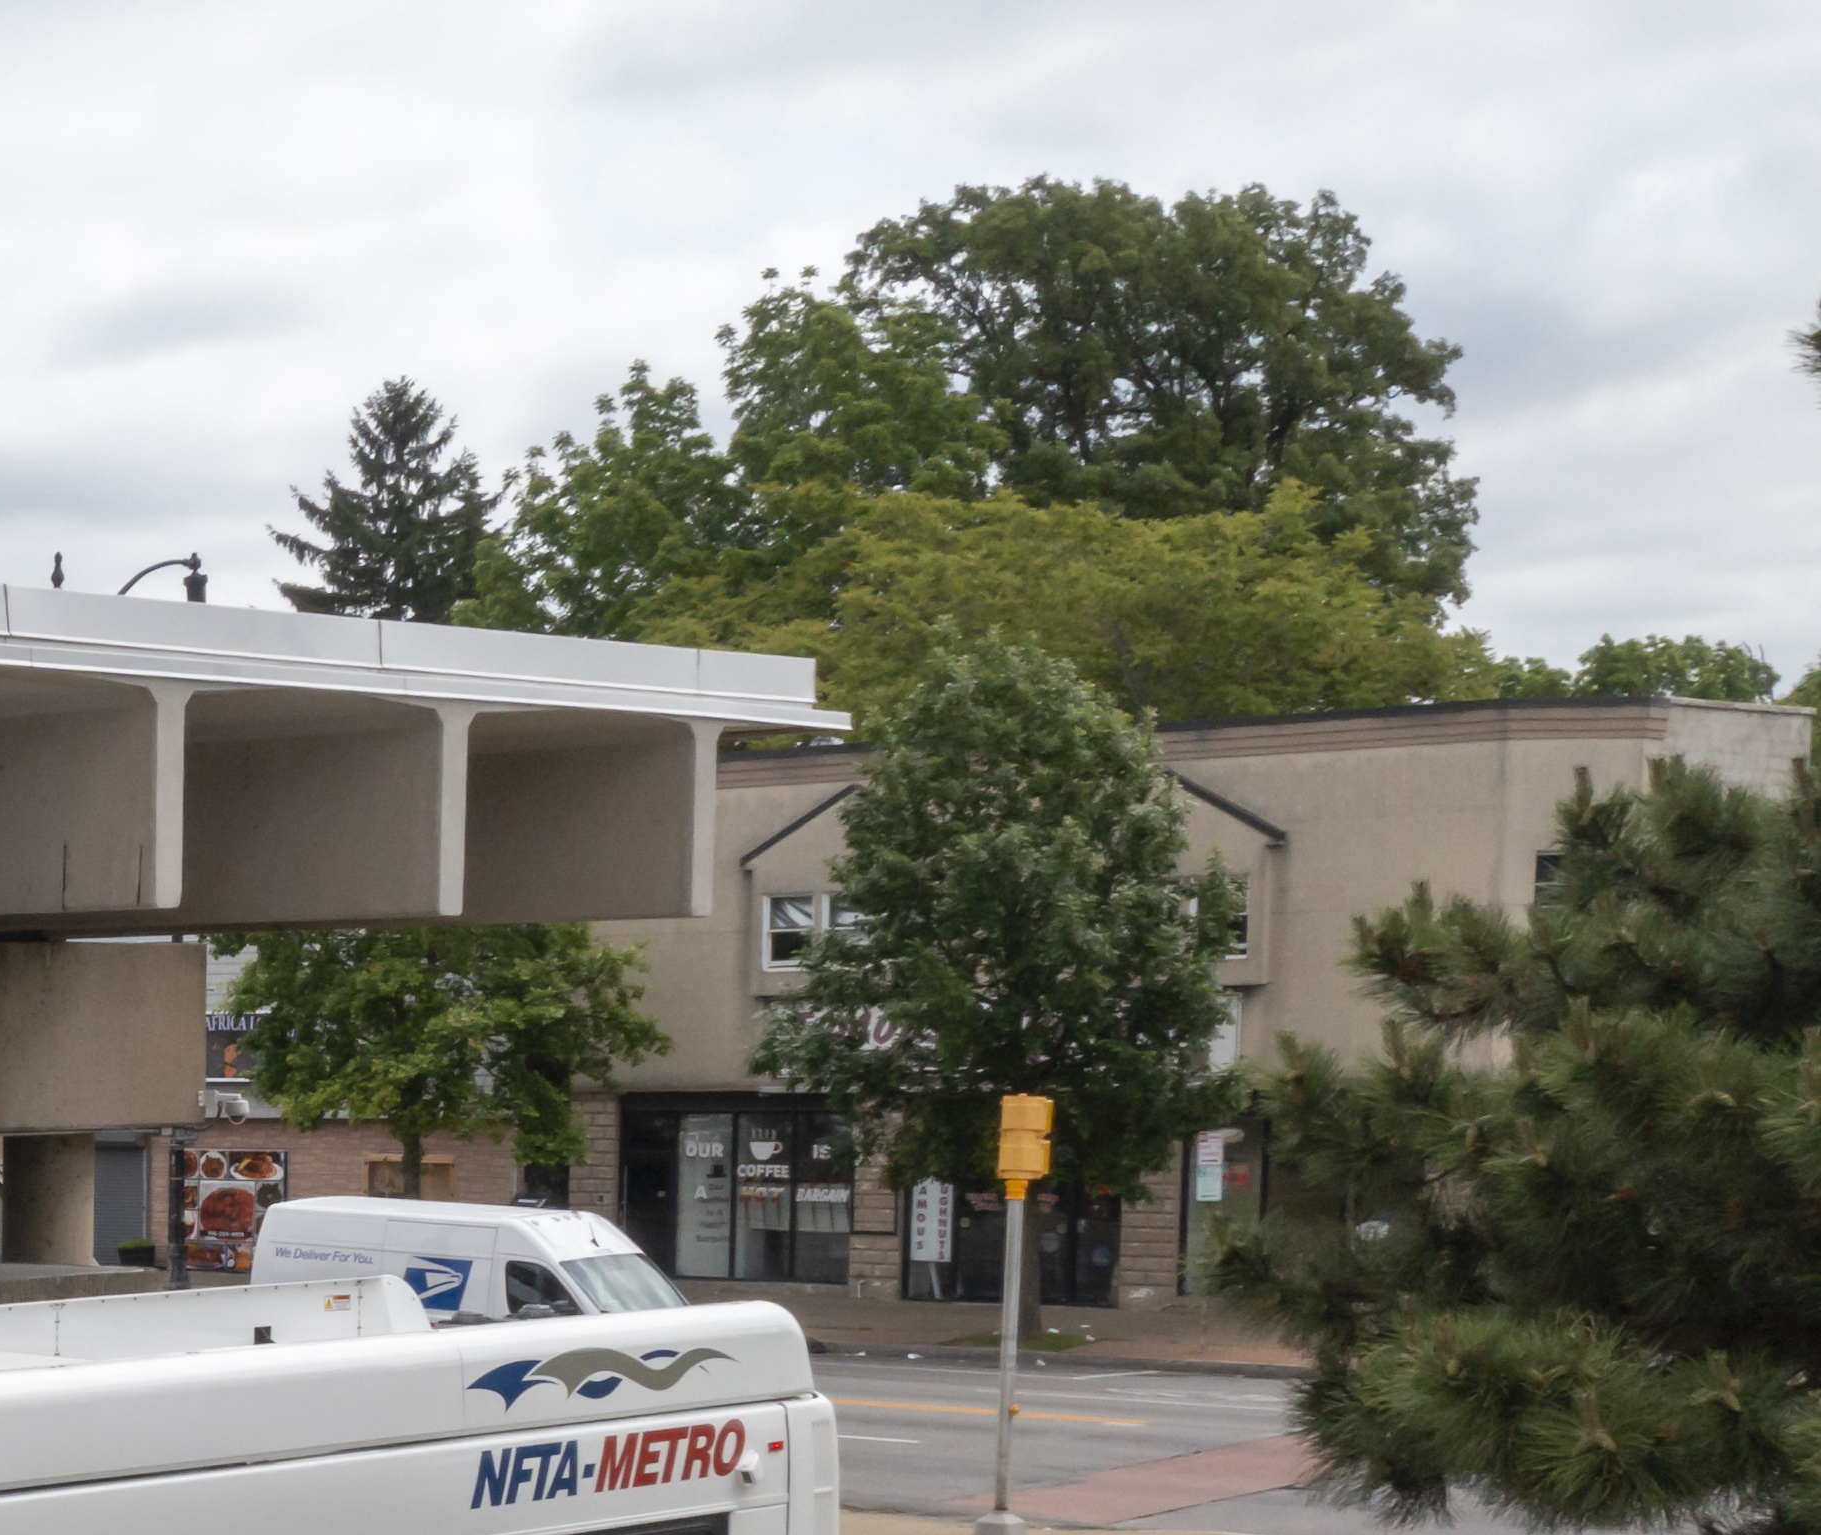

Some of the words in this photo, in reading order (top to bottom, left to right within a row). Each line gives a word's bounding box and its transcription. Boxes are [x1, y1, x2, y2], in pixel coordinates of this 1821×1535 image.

[684, 1141, 724, 1158] OUR
[812, 1144, 832, 1160] IS
[737, 1164, 790, 1178] COFFEE
[694, 1185, 708, 1200] A
[739, 1186, 785, 1203] HOT
[795, 1188, 850, 1203] BARGAIN
[915, 1185, 928, 1250] AMOUS
[937, 1183, 950, 1260] UGHNUTS
[275, 1247, 292, 1258] We
[293, 1248, 331, 1262] Deliver
[332, 1251, 351, 1263] For
[469, 1418, 746, 1510] NFTA-METRO
